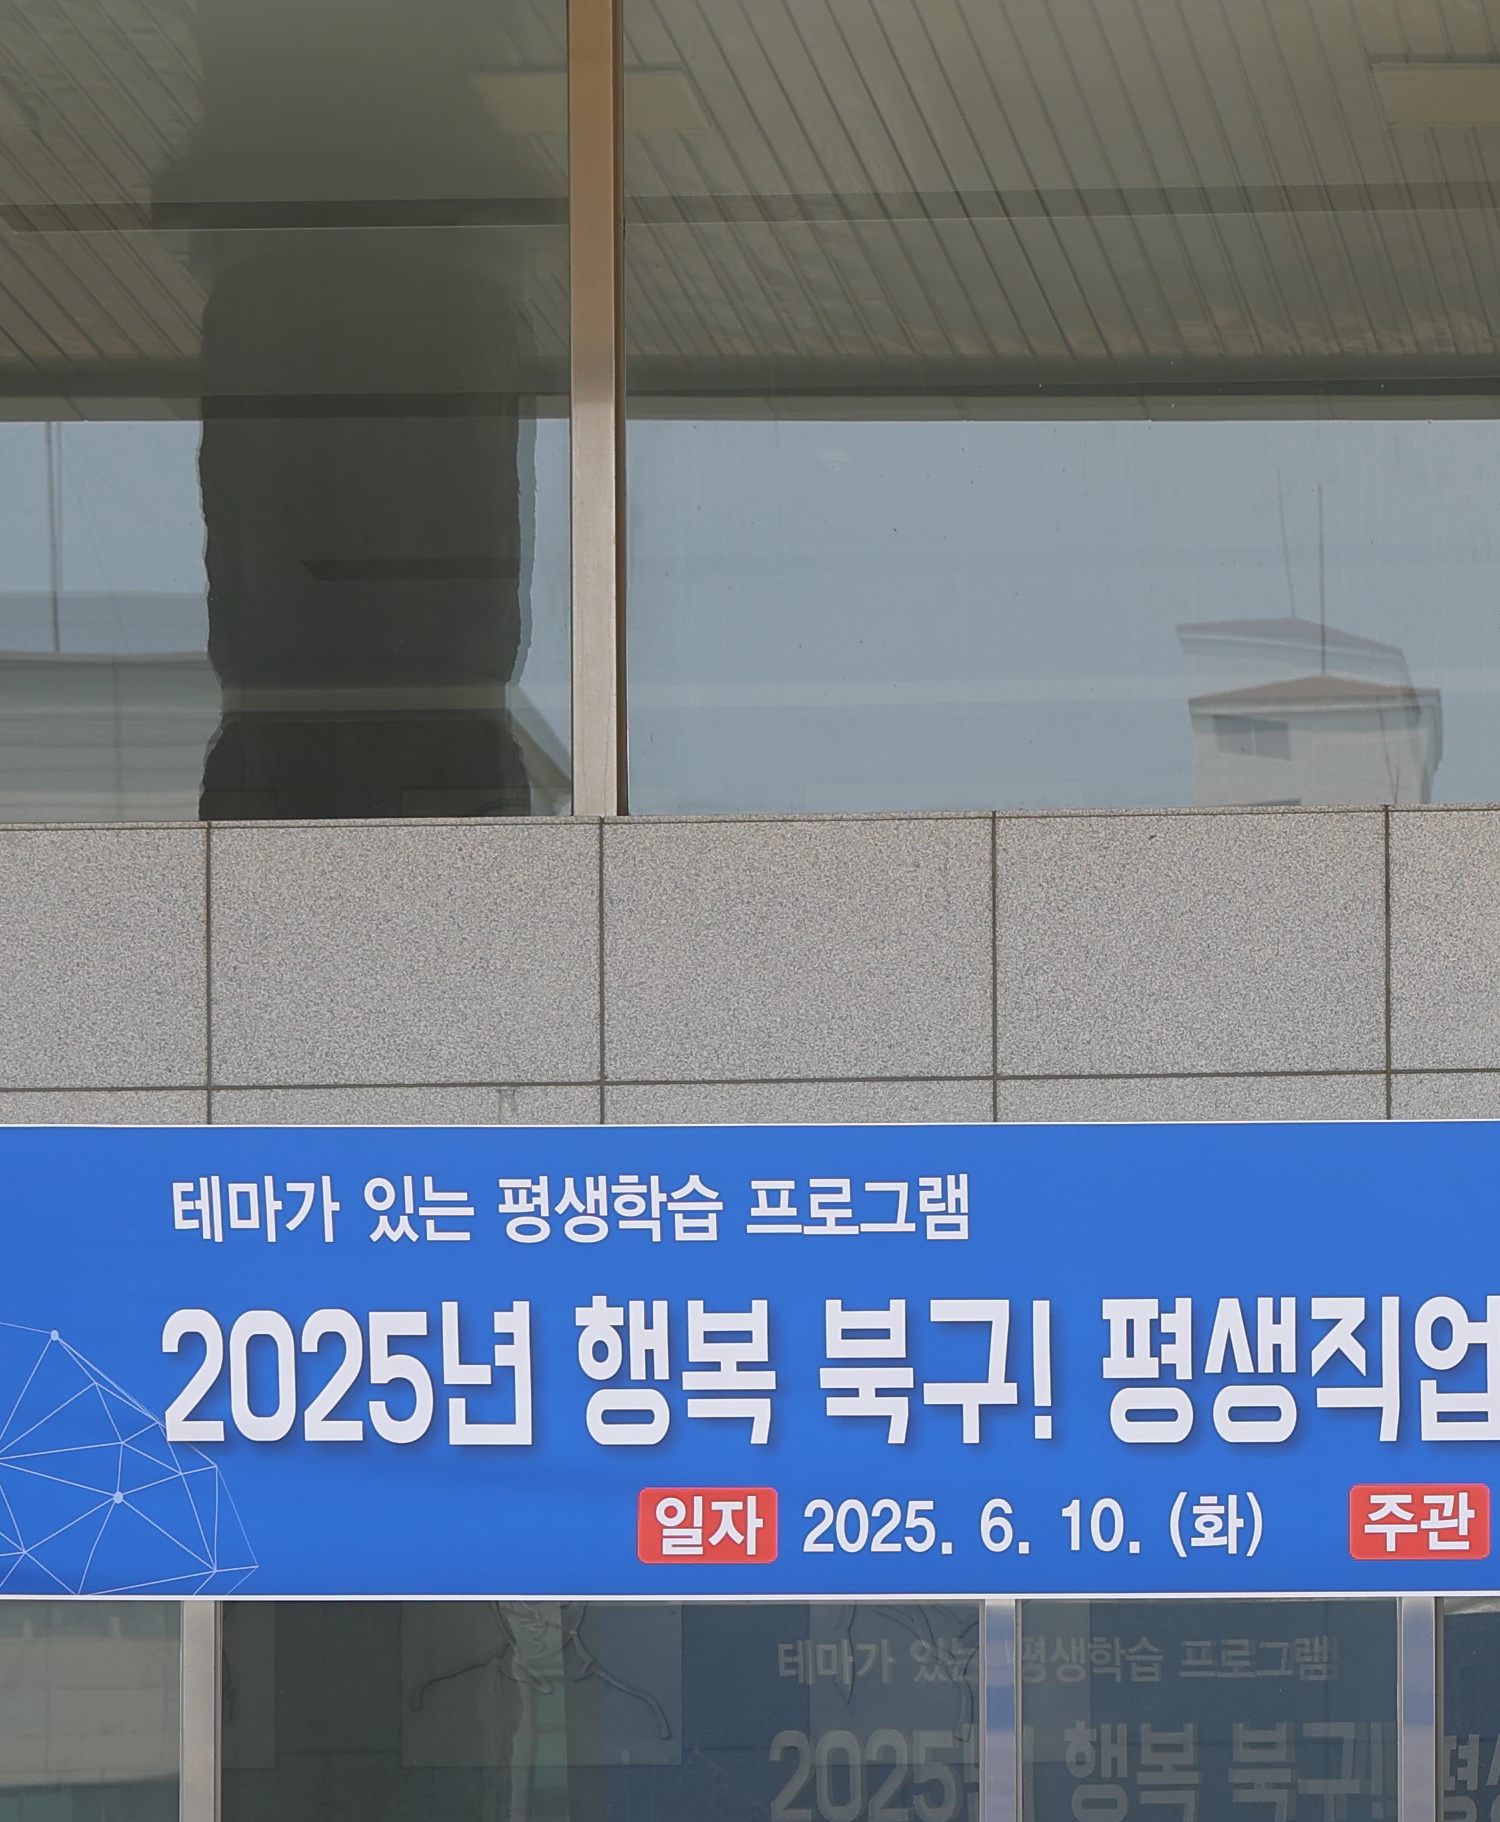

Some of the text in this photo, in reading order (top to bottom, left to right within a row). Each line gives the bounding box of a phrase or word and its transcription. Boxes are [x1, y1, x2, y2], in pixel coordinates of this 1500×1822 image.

[172, 1173, 969, 1244] 테마가 있는 평생학습 프로그램
[162, 1300, 532, 1445] 2025년
[575, 1295, 776, 1445] 행복
[819, 1299, 1052, 1444] 북구!
[654, 1491, 1263, 1558] 일자 2025. 6. 10. (화)
[1364, 1491, 1476, 1553] 주관
